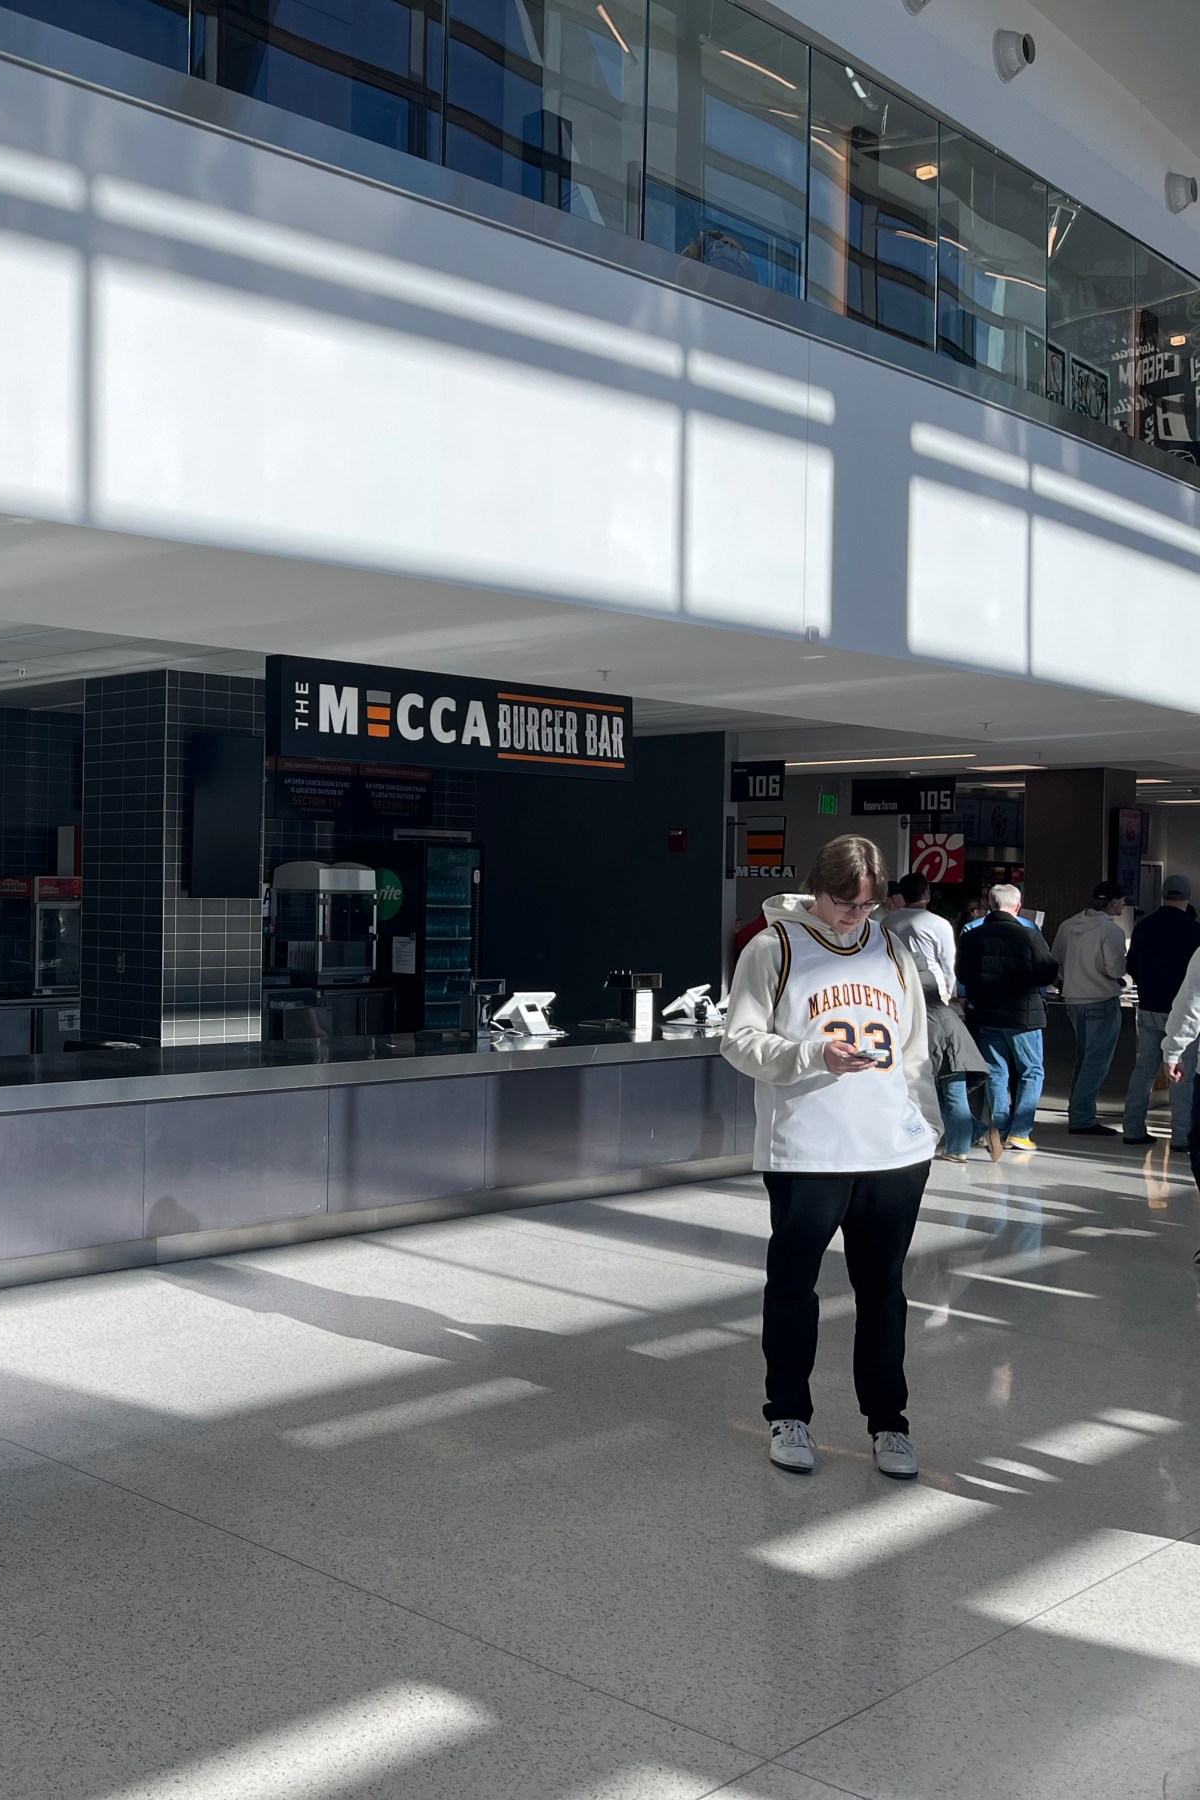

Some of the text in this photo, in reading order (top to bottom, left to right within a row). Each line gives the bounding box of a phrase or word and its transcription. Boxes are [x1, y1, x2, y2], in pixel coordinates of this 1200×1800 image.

[295, 681, 309, 729] THE
[318, 684, 624, 759] MECCA BURGER BAR
[748, 775, 780, 797] 106
[292, 796, 341, 807] SECTION 116
[920, 791, 951, 810] 105
[736, 866, 793, 877] MECCA
[378, 885, 401, 900] rite
[808, 983, 899, 1024] MARQUETTE
